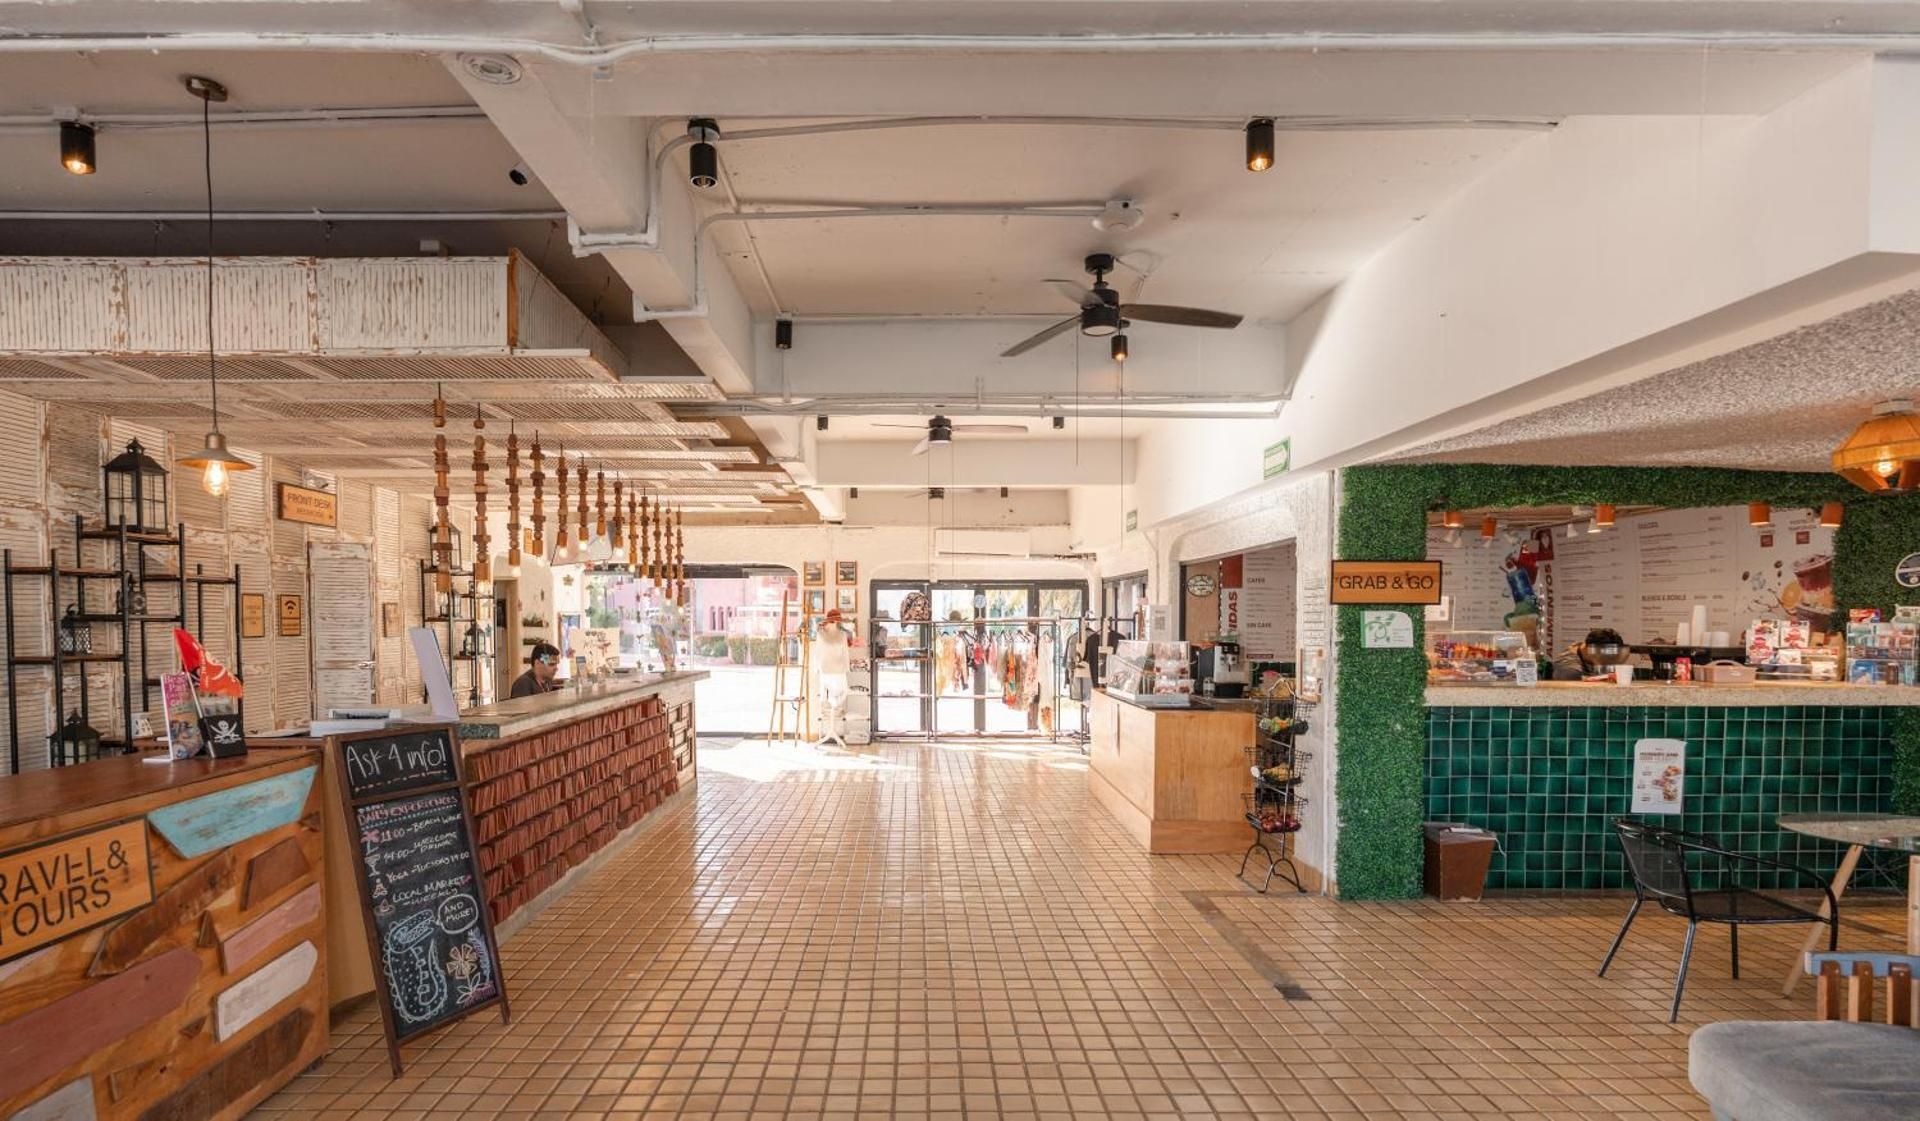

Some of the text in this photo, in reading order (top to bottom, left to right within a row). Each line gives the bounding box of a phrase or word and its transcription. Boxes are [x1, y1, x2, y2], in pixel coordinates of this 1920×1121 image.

[1339, 575, 1387, 590] GRAB
[1391, 575, 1404, 590] &
[1407, 575, 1434, 590] GO
[1228, 591, 1238, 632] IDAS
[1544, 563, 1555, 658] ALIMENTOS
[345, 737, 448, 786] Ask 4 info!
[392, 889, 422, 903] LOCAL
[443, 901, 464, 914] AND
